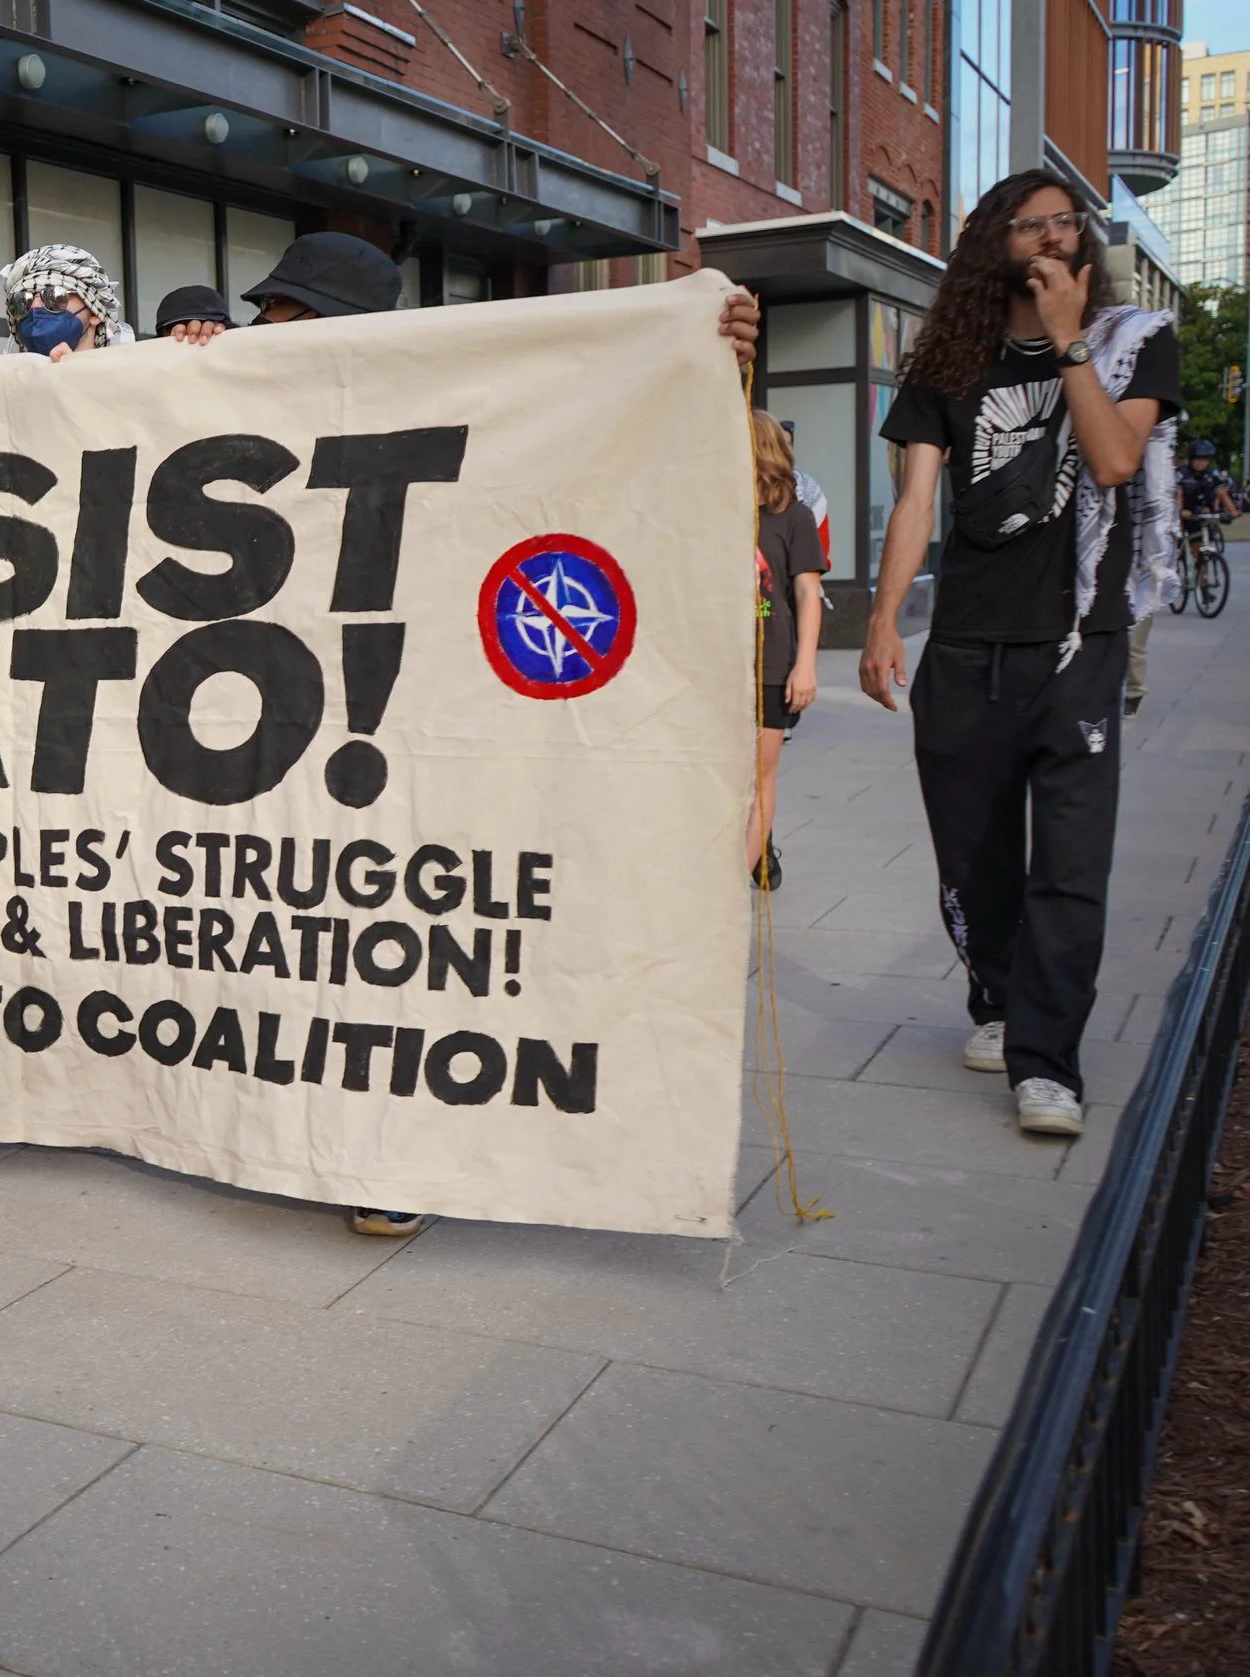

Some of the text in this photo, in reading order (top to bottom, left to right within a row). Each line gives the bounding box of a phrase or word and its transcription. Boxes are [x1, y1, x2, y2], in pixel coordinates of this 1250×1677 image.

[156, 830, 553, 922] STRUGGLE
[1, 894, 47, 959] &
[68, 899, 521, 998] LIBERATION!
[76, 990, 598, 1114] COALITION
